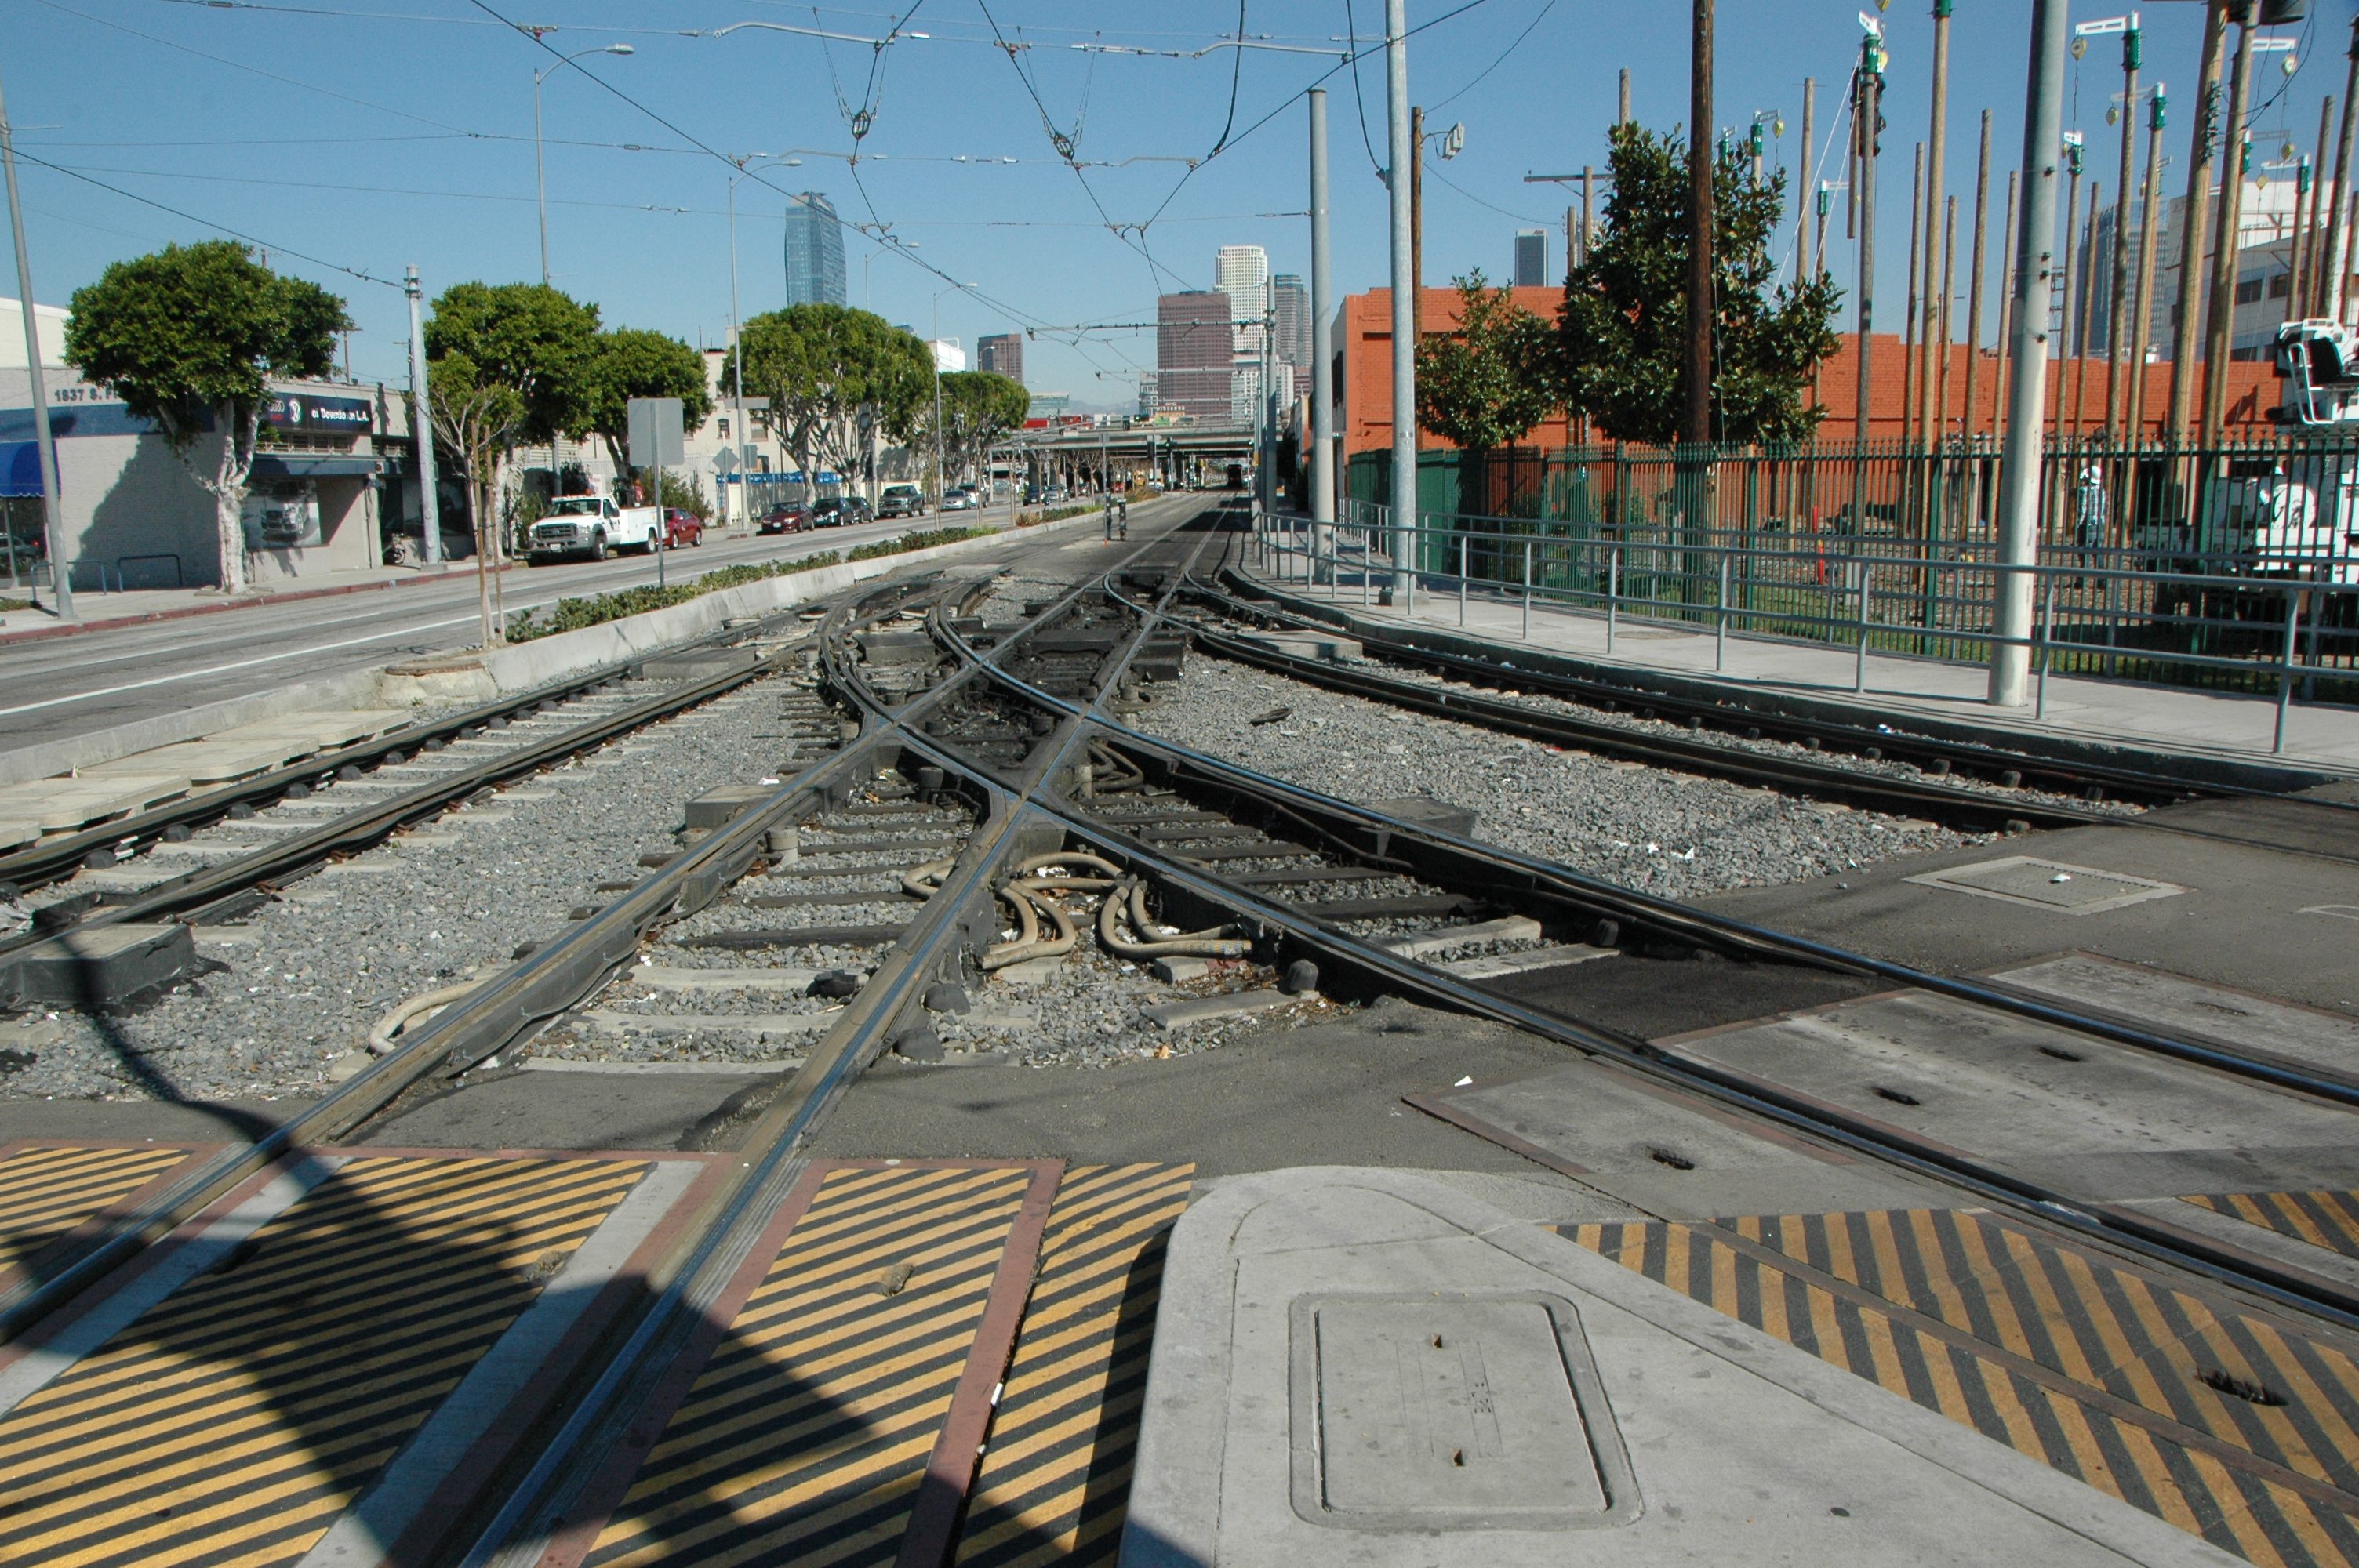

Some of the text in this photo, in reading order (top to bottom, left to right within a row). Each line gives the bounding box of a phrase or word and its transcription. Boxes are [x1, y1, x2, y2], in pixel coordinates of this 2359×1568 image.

[54, 388, 84, 402] 1837
[89, 387, 102, 401] S.
[320, 407, 356, 421] Downton
